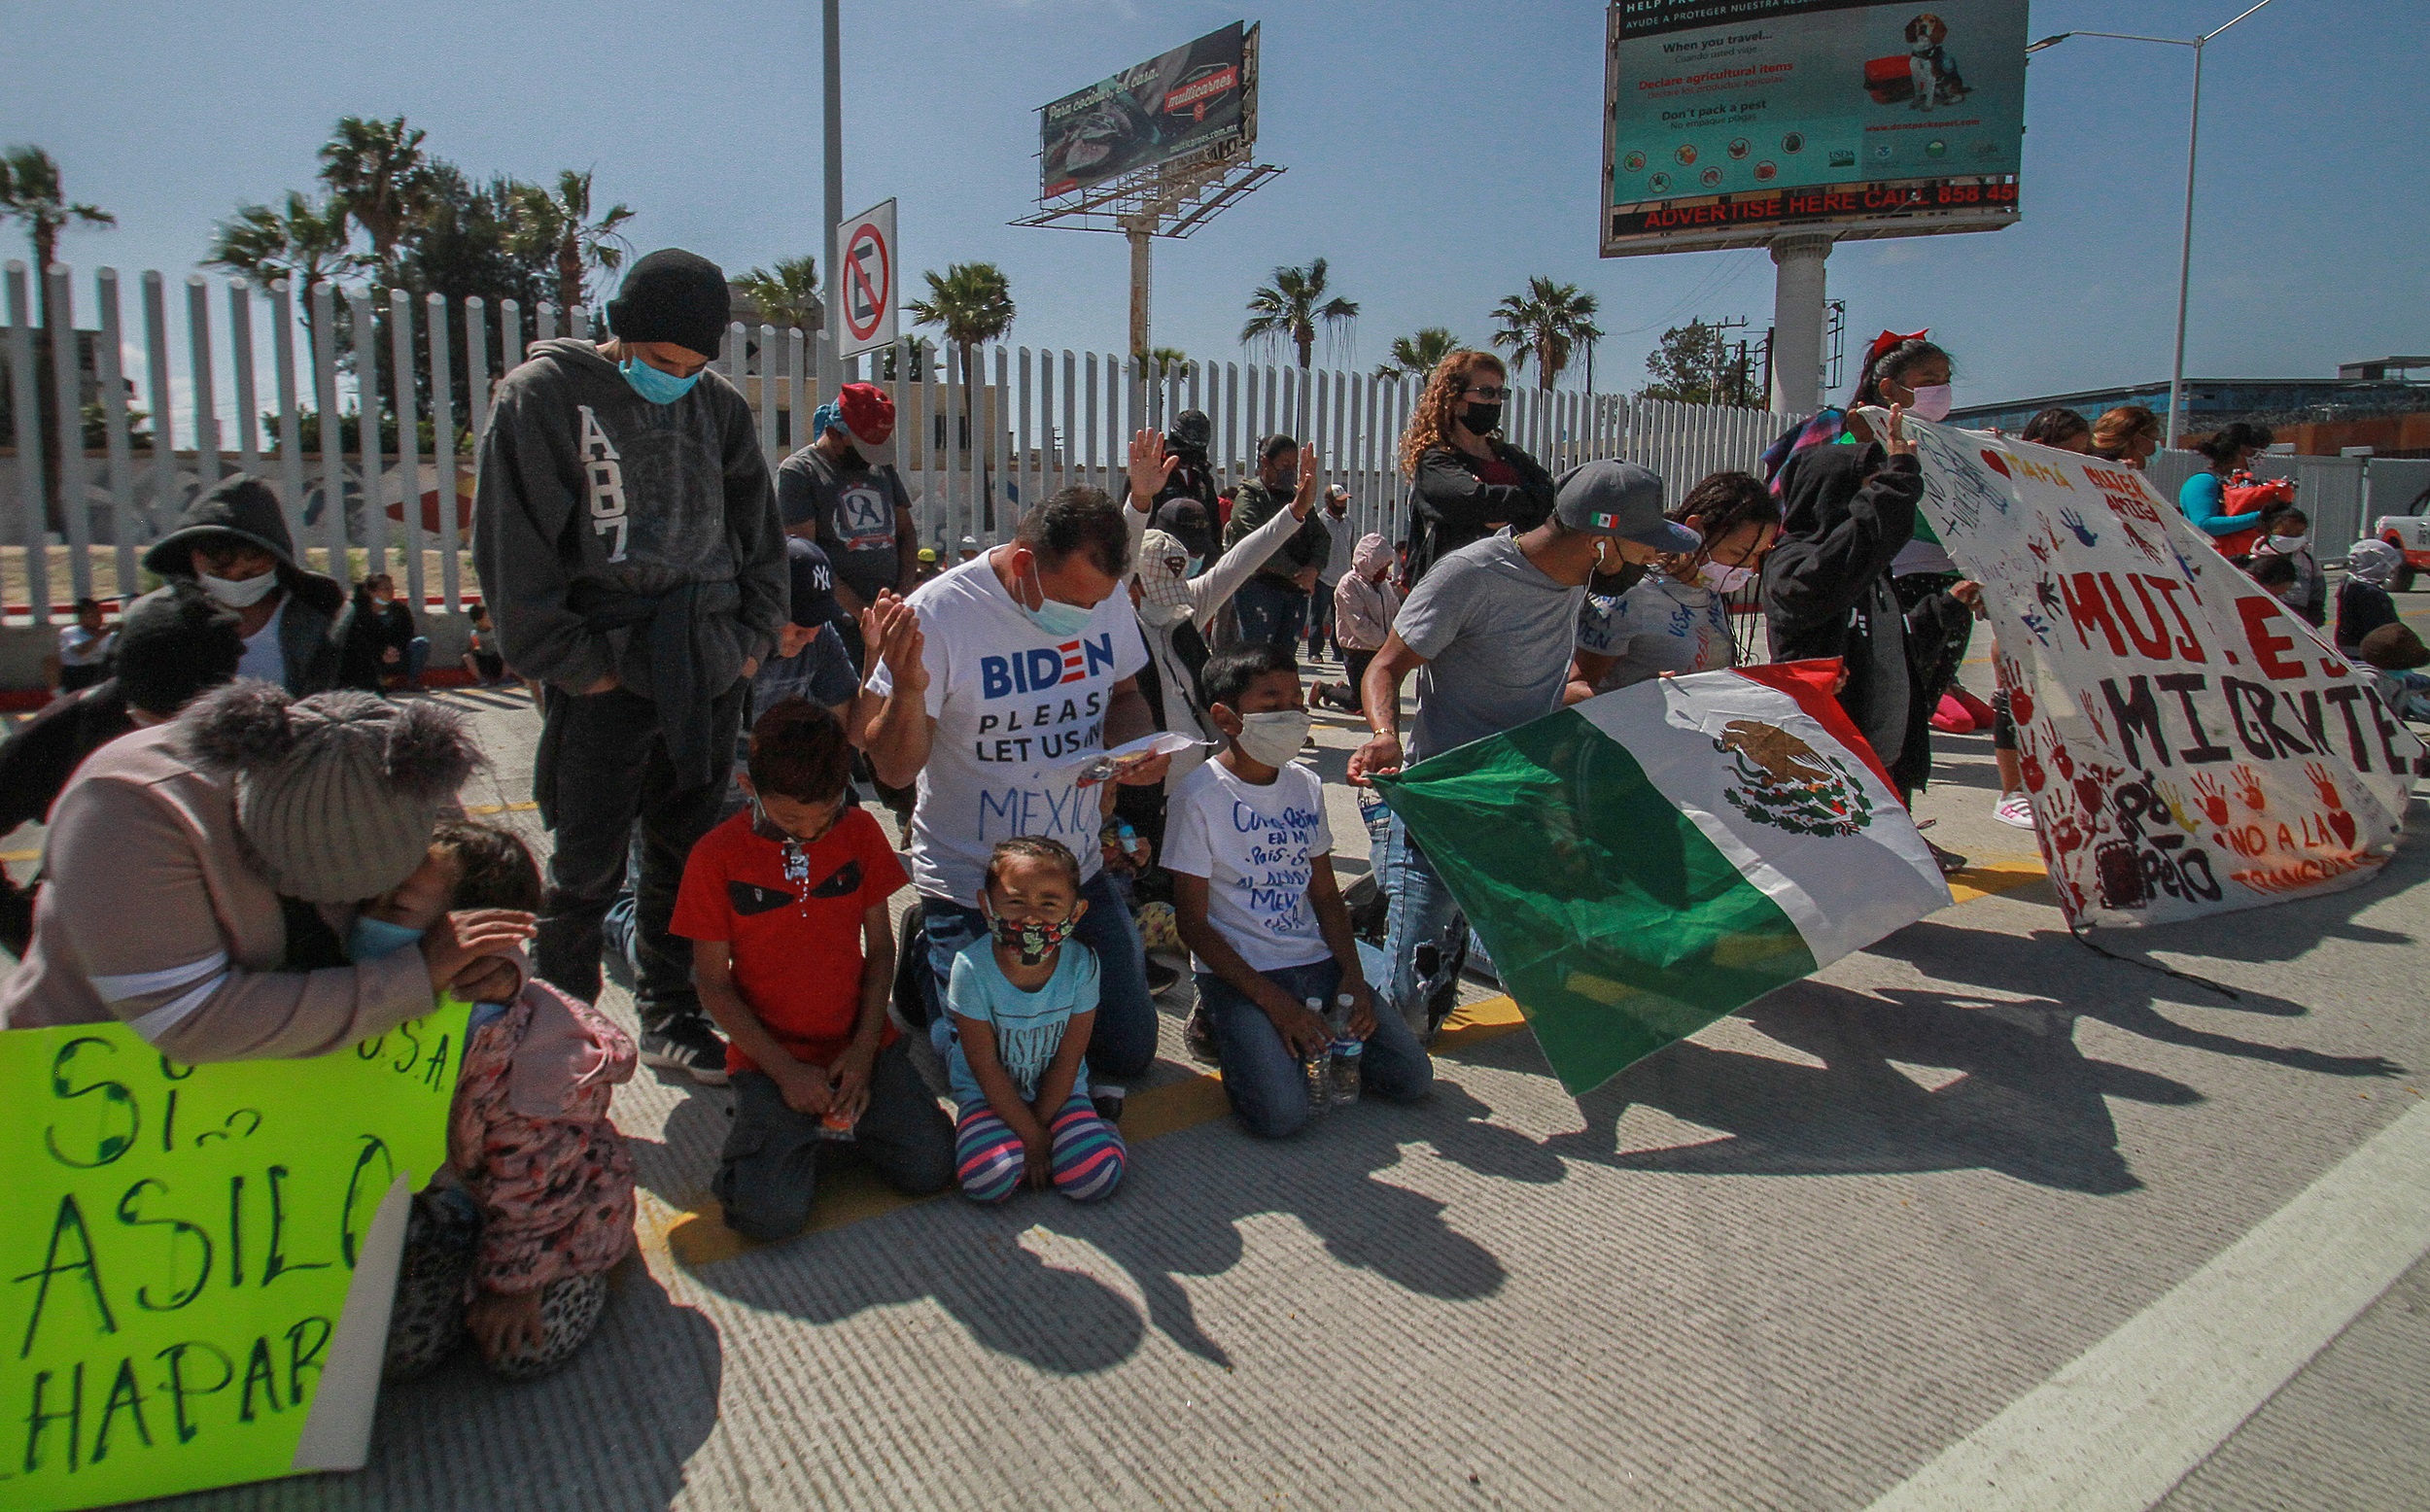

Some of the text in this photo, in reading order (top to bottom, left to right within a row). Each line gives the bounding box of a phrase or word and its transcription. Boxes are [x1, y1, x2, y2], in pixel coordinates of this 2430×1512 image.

[1626, 17, 1658, 28] AYUDE
[1674, 7, 1726, 21] PROTEGER
[1730, 0, 1780, 13] NUESTRA
[1663, 42, 1697, 52] When
[1702, 37, 1723, 51] you
[1675, 52, 1709, 63] Cuando
[1711, 47, 1735, 58] usted
[1639, 62, 1793, 90] Declare agricultural items
[1168, 75, 1233, 108] multicarnes
[1049, 104, 1072, 121] Para
[1662, 99, 1767, 120] Don't pack a pest
[1670, 112, 1757, 130] No empaque plagas
[1645, 184, 2019, 228] ADVERTISE HERE CALL 858 45
[981, 633, 1115, 700] BIDEN
[979, 685, 1114, 736] PLEAS
[976, 738, 1032, 763] LET
[1041, 730, 1080, 760] US
[1268, 831, 1288, 845] EN
[2228, 811, 2334, 858] NO A LA
